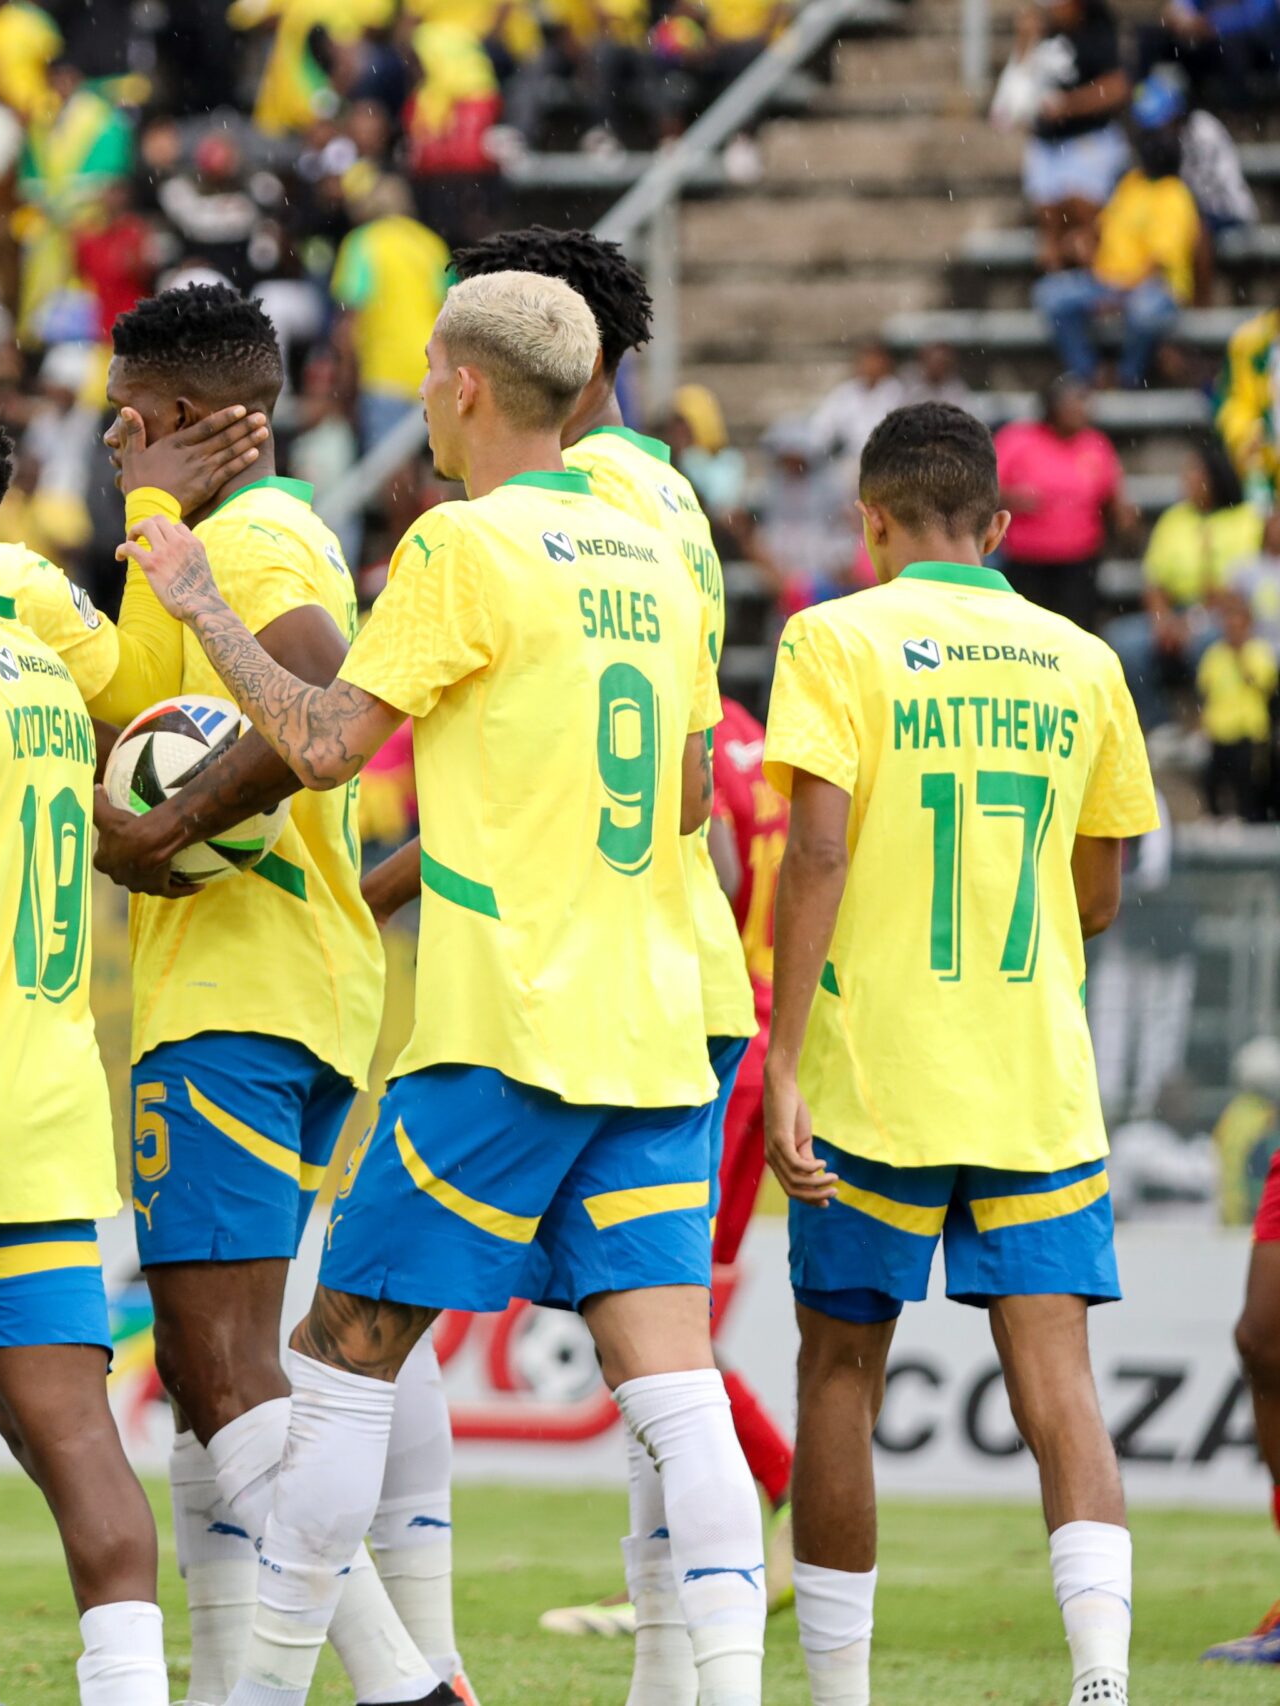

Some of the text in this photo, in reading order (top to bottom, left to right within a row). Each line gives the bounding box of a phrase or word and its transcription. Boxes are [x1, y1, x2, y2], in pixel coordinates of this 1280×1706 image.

[577, 538, 659, 564] NEDBANK
[579, 588, 661, 643] SALES
[946, 644, 1061, 672] NEDBANK
[893, 697, 1079, 759] MATTHEWS
[596, 662, 660, 876] 9
[12, 784, 90, 1004] 19
[921, 770, 1056, 982] 17
[135, 1081, 171, 1182] 5
